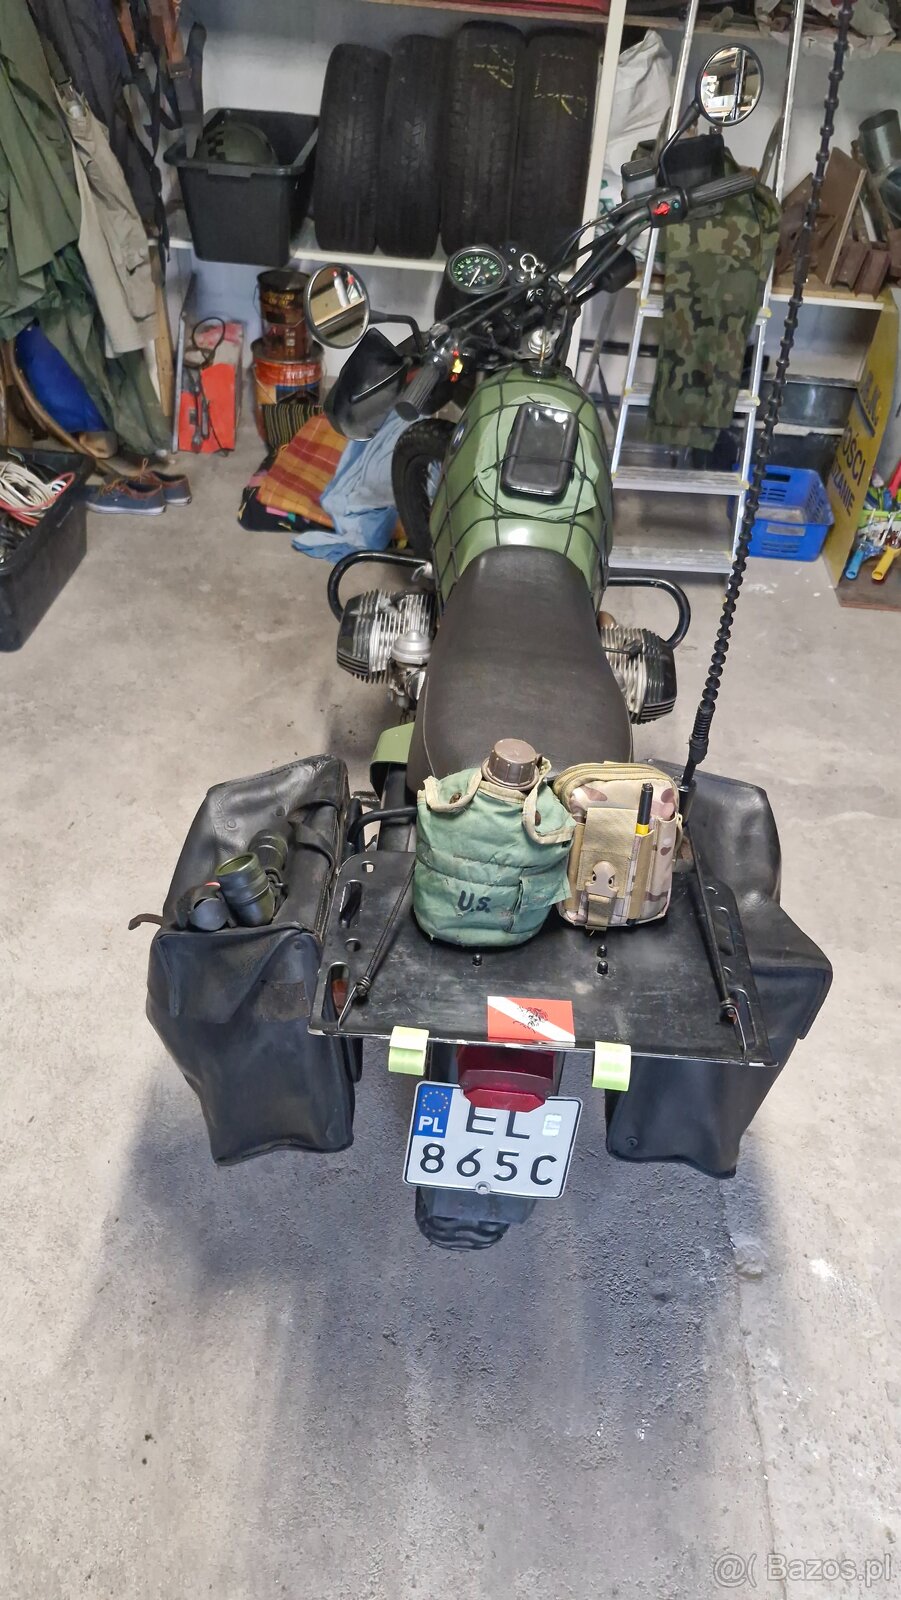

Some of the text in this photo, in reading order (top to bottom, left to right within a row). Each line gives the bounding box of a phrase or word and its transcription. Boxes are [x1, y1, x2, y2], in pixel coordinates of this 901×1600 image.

[457, 890, 491, 913] U.S.
[418, 1116, 443, 1134] PL
[466, 1105, 531, 1140] EL
[419, 1142, 558, 1186] 865C
